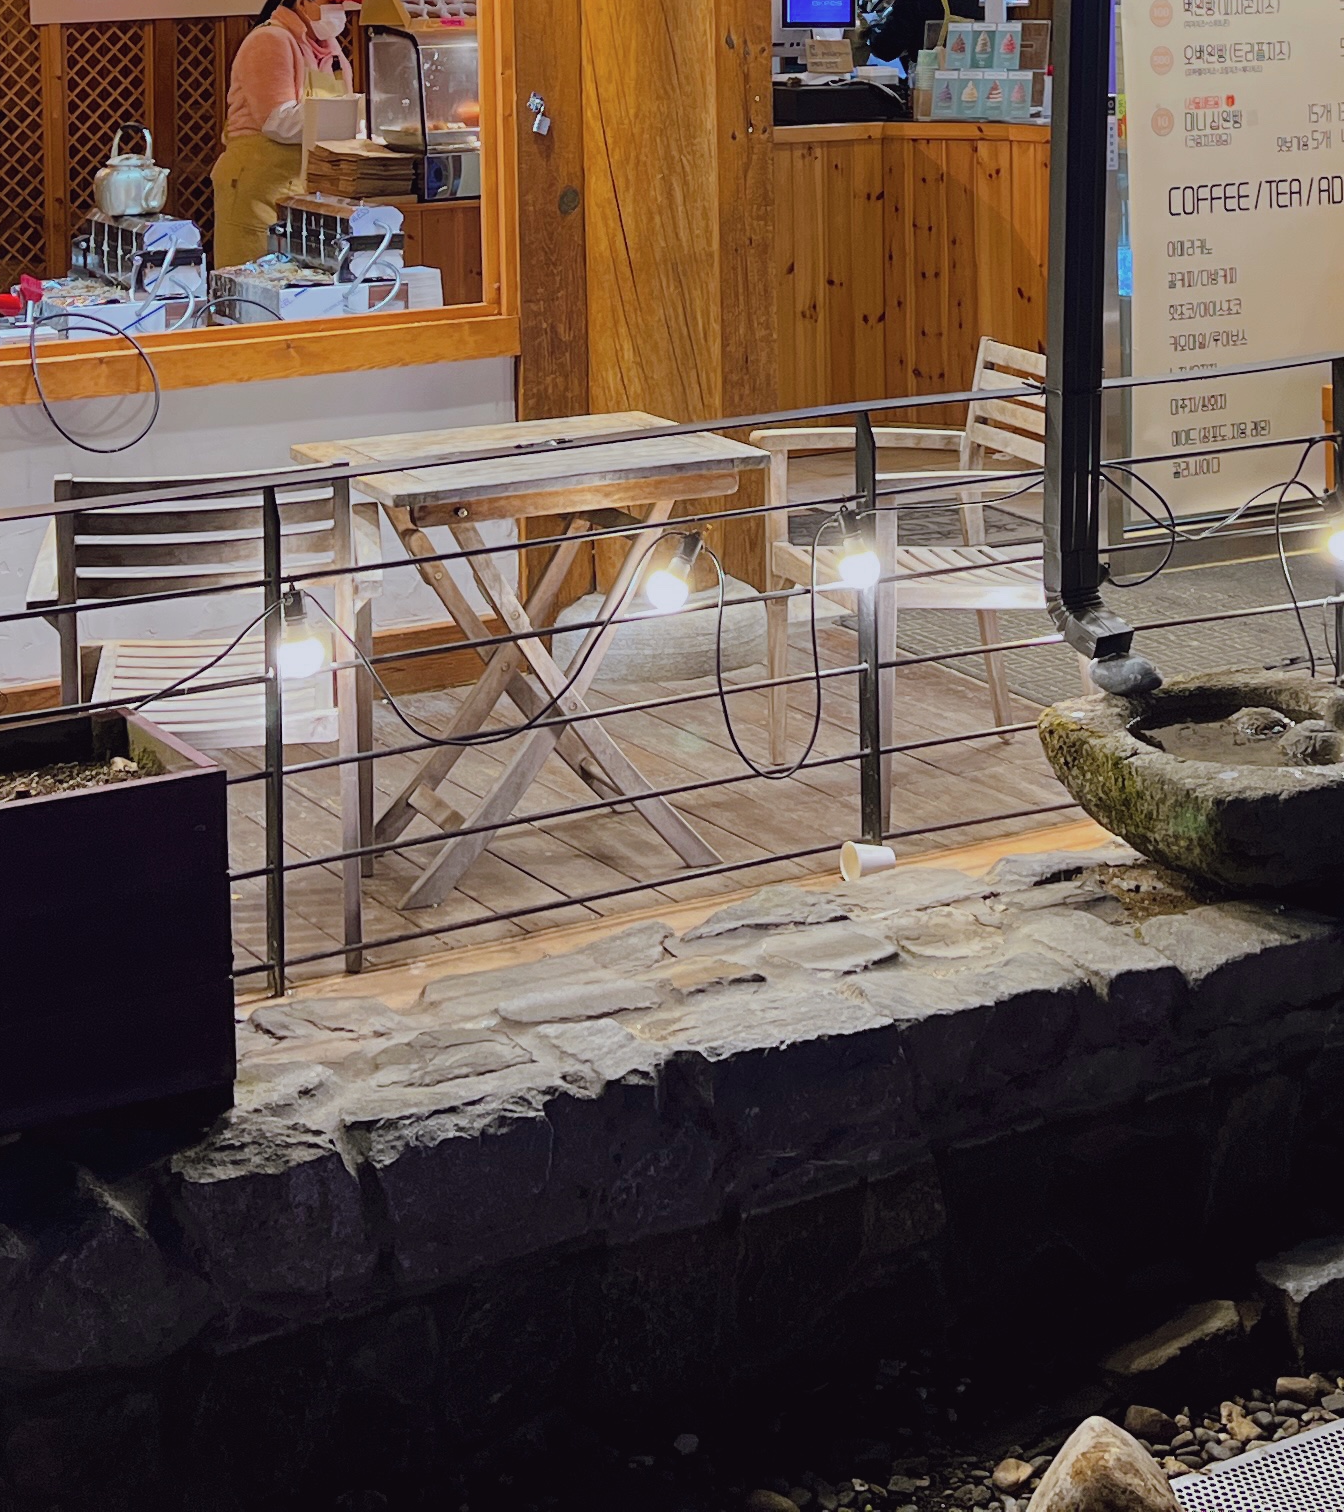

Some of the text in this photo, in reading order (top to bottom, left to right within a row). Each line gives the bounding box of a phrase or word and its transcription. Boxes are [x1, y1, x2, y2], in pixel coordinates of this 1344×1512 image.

[1184, 111, 1206, 132] 미니
[1209, 109, 1243, 131] 십원빵
[1307, 102, 1332, 124] 15개
[1167, 238, 1213, 258] 아메리카노
